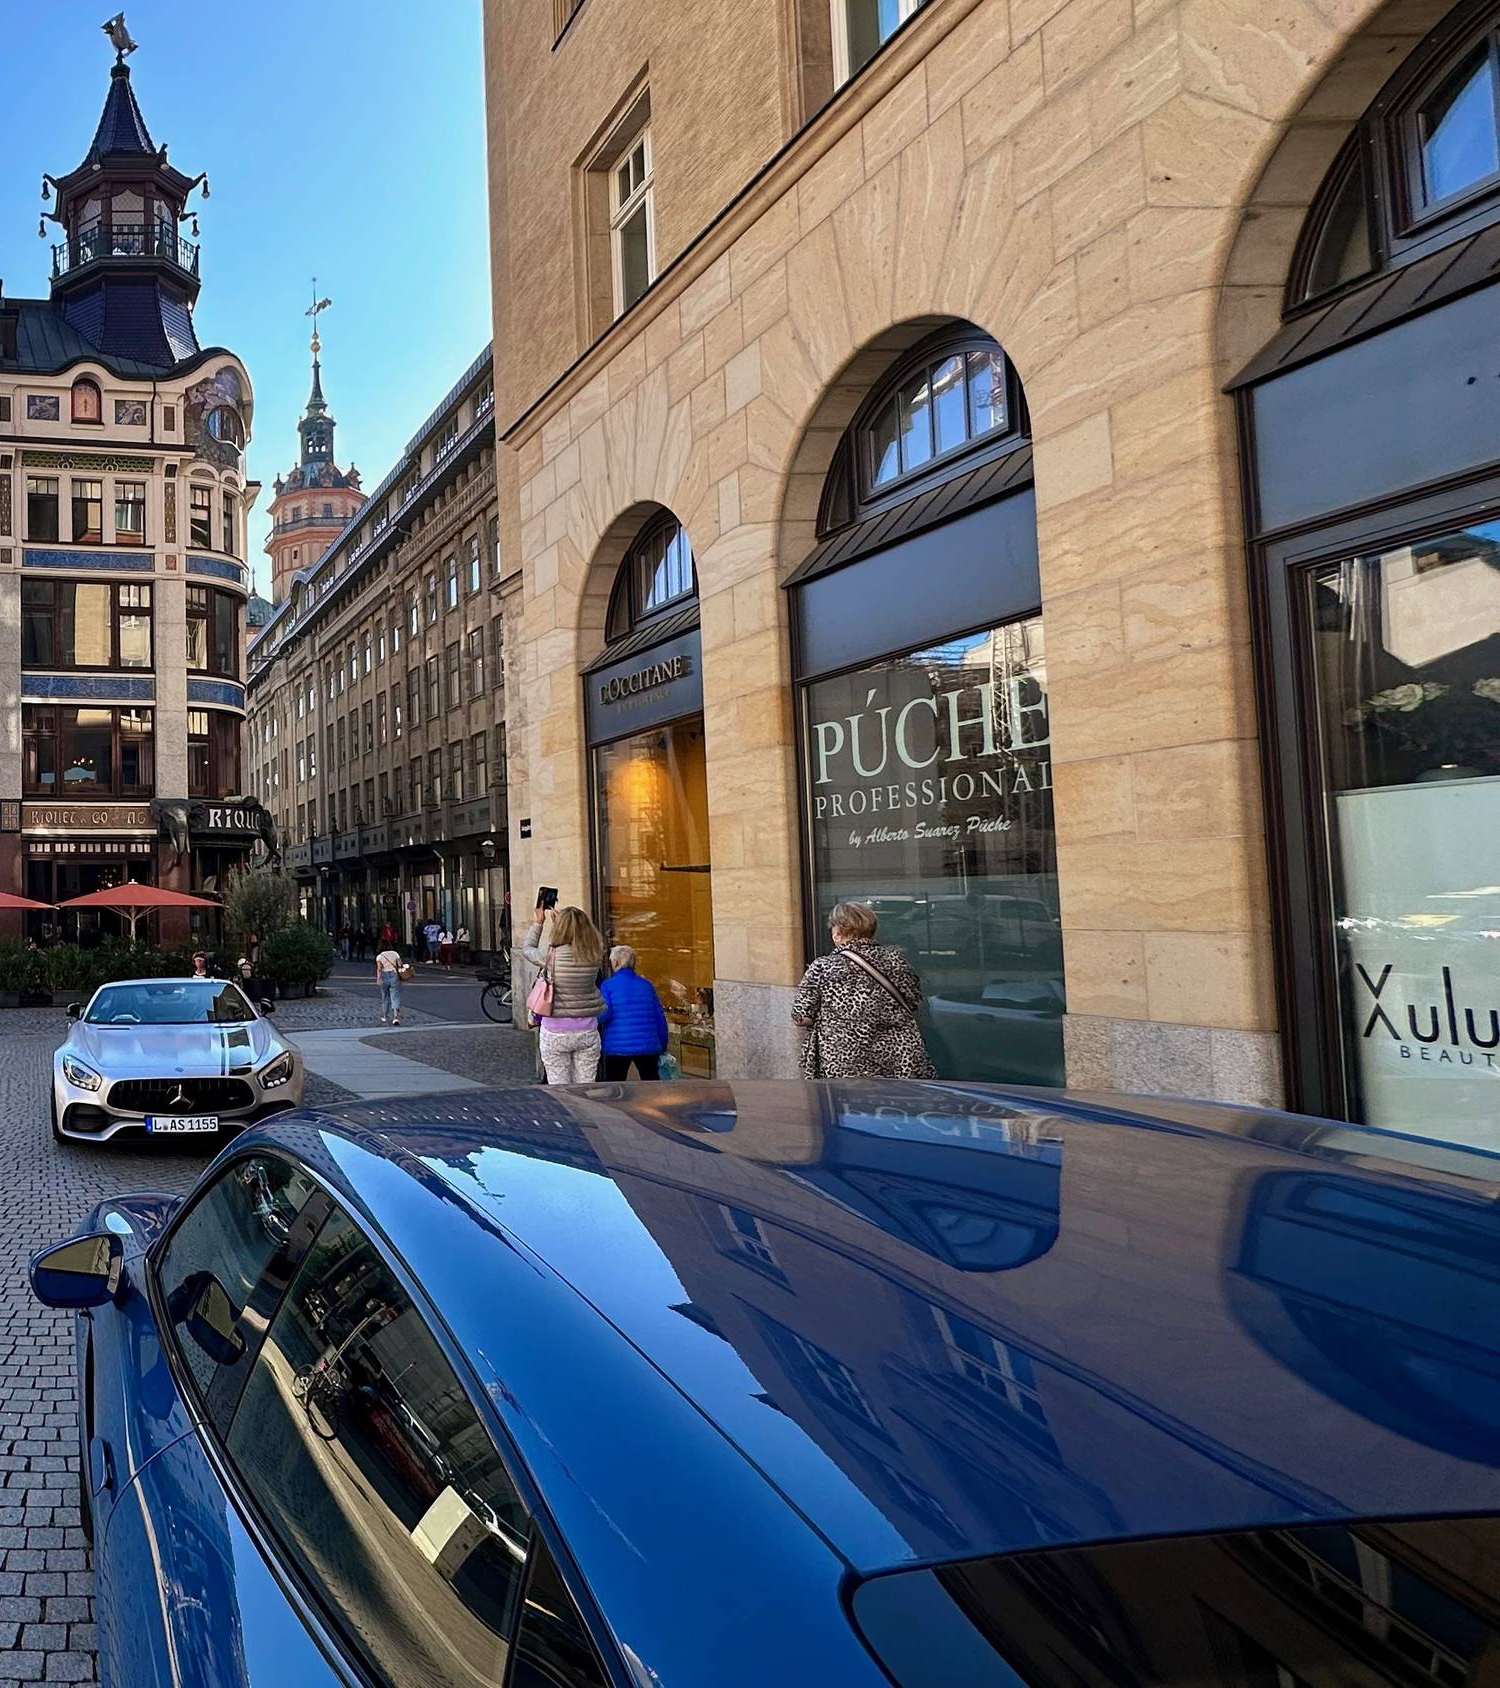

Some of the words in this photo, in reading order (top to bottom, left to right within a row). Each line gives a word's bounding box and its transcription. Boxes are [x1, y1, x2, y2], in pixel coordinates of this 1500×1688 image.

[812, 673, 1050, 784] PÚCHE
[815, 760, 1053, 820] PROFESSIONAL
[848, 829, 861, 848] by
[864, 826, 909, 844] Alberto
[914, 821, 961, 840] Suarez
[1356, 963, 1500, 1049] Xulu
[1400, 1045, 1496, 1067] BEAUT
[153, 1118, 162, 1131] L
[170, 1118, 185, 1131] AS
[188, 1118, 217, 1131] 1155
